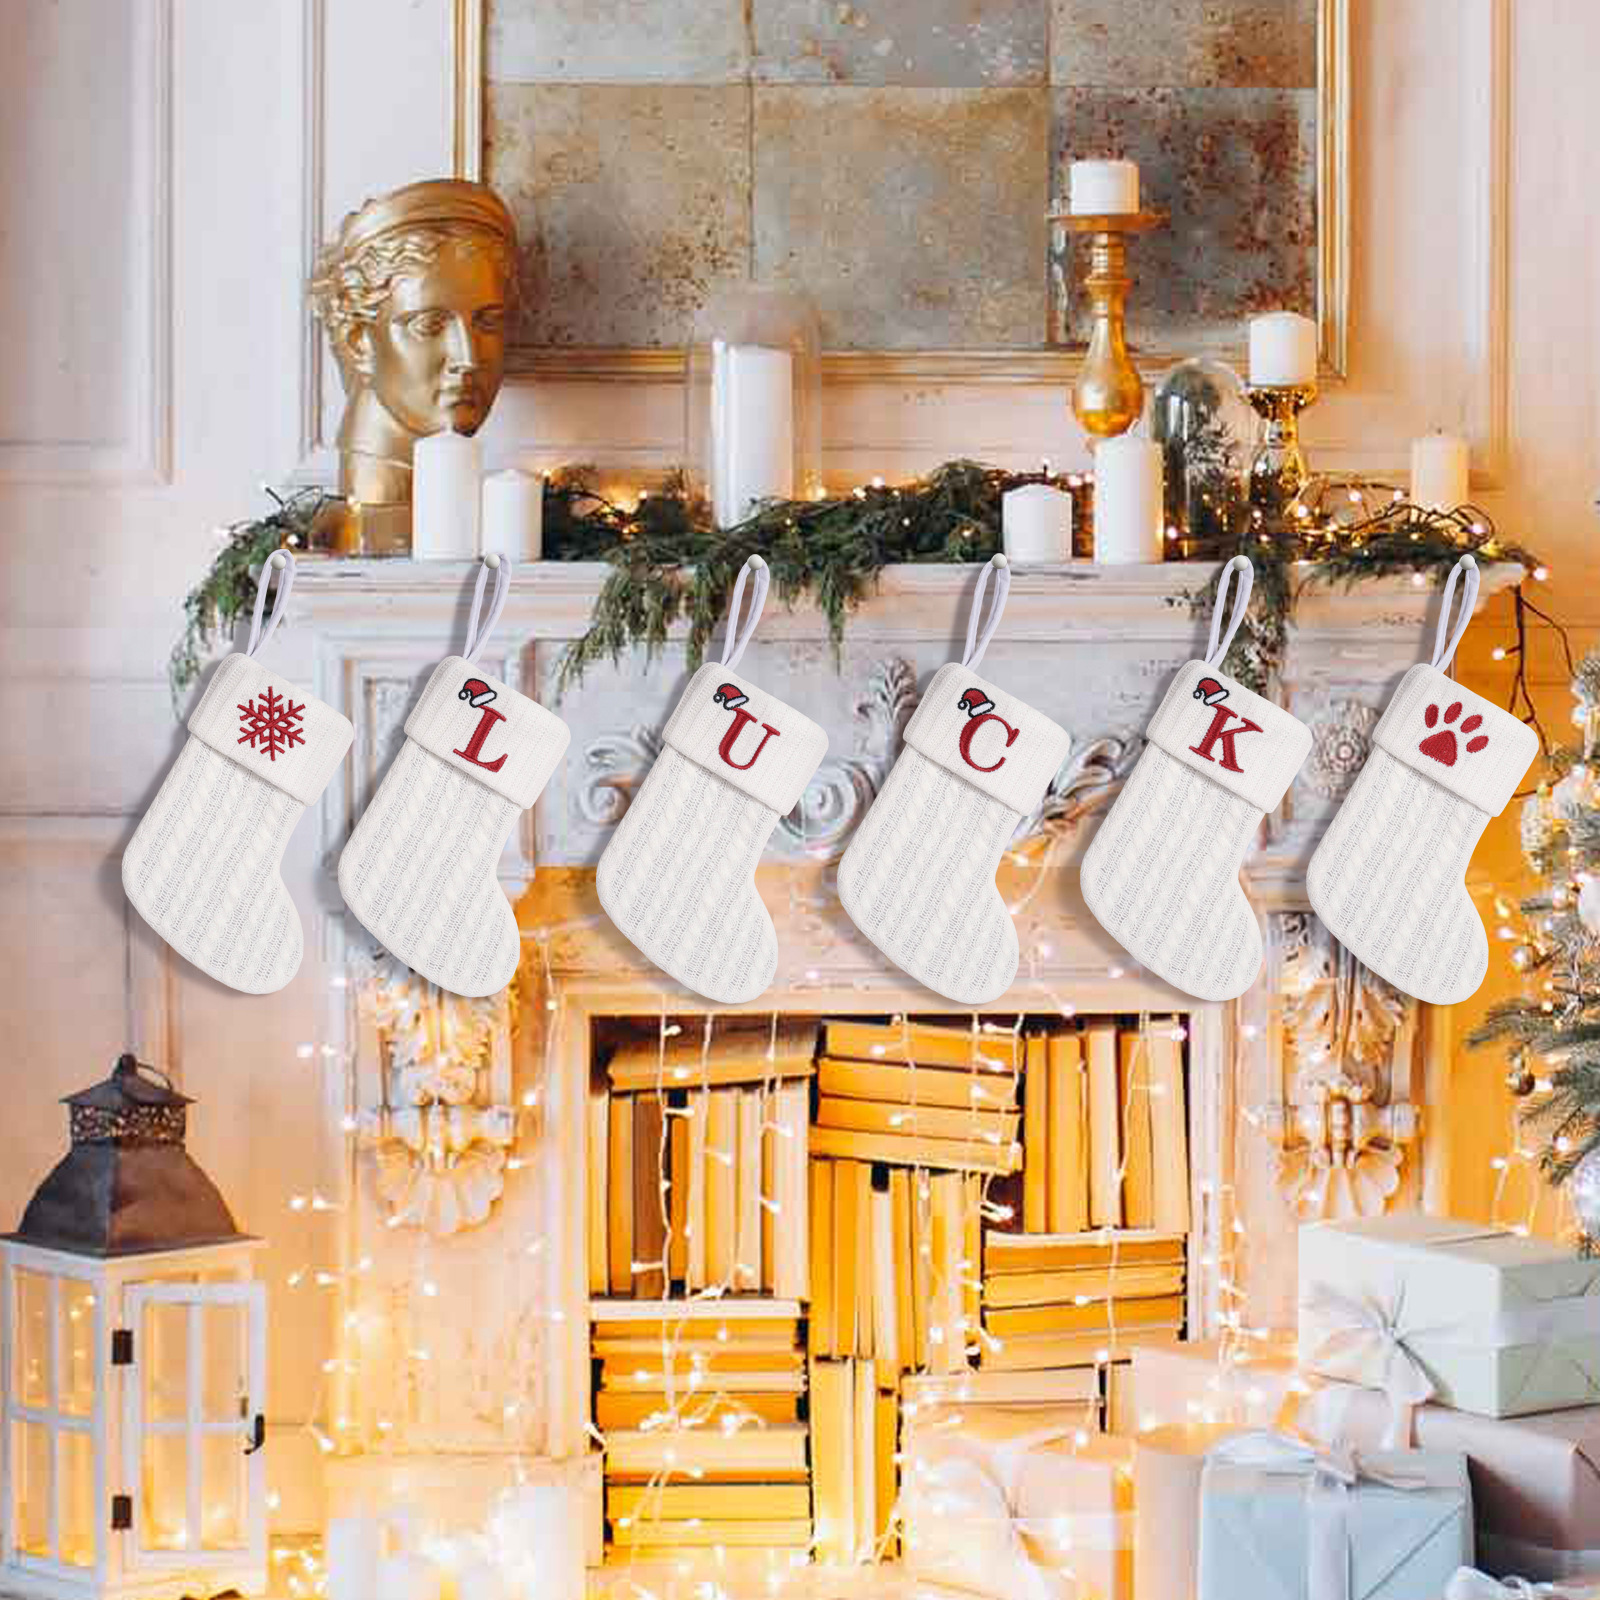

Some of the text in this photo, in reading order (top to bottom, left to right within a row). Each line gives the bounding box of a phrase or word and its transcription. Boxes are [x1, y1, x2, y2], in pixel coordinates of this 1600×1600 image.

[453, 704, 508, 773] L
[718, 706, 781, 770] U
[959, 713, 1020, 773] C
[1188, 703, 1264, 773] K
